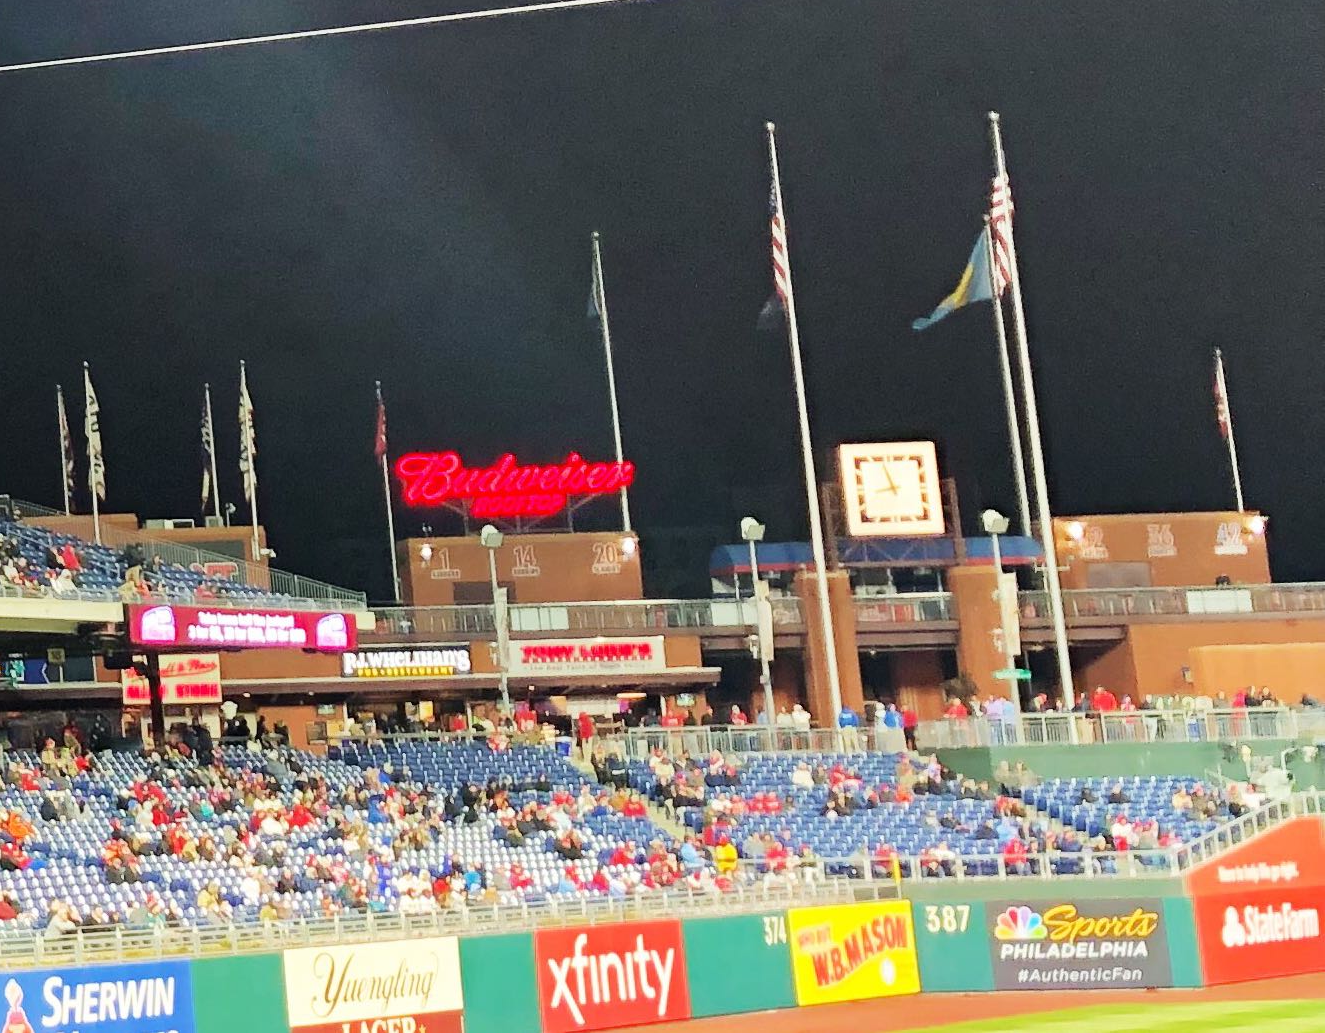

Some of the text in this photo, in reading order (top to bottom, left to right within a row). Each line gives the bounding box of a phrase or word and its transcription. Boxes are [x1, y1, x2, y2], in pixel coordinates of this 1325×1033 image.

[395, 451, 636, 507] Budweiser
[472, 495, 567, 519] ROOFTOP
[438, 541, 618, 570] 1 14 20
[763, 916, 787, 946] 374
[925, 905, 970, 933] 387
[1043, 902, 1159, 943] Sports
[1000, 940, 1148, 961] PHILADELPHIA
[312, 950, 439, 1017] Yuengling
[548, 933, 675, 1025] xfinity
[1017, 966, 1143, 984] #AuthenticFan
[42, 976, 176, 1027] SHERWIN
